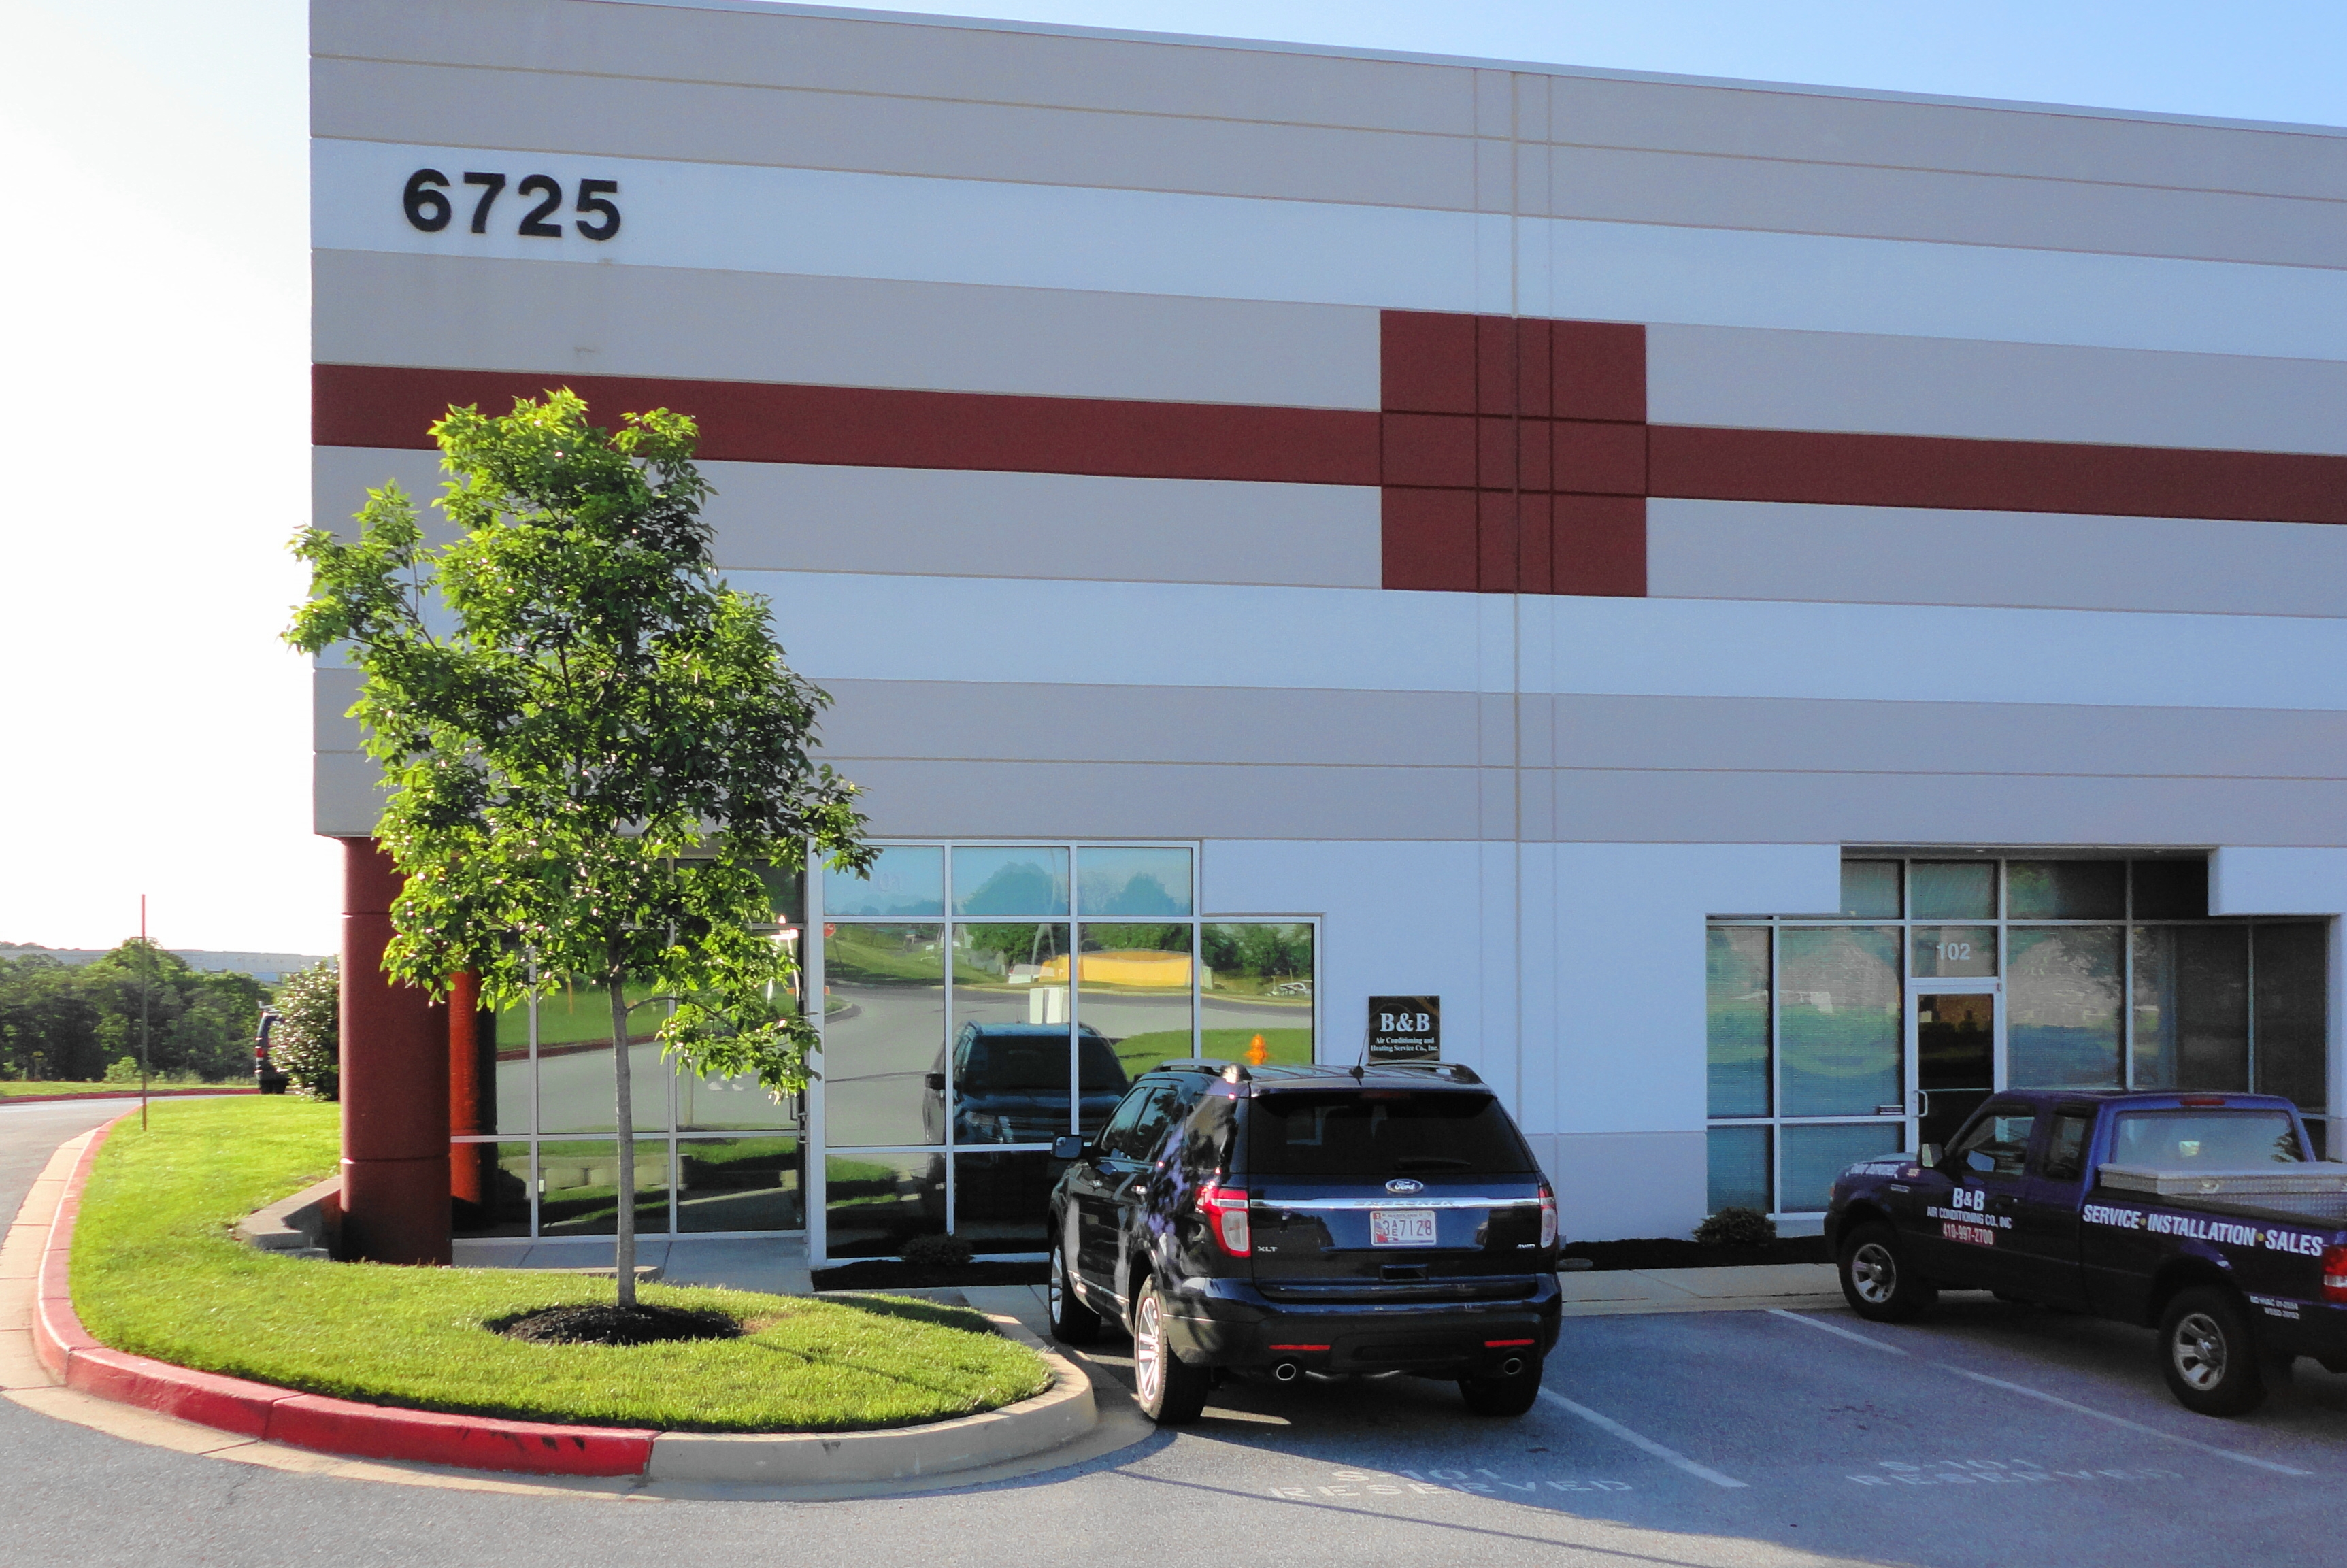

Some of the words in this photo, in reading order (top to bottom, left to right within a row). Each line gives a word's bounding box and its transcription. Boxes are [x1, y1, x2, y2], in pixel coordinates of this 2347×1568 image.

[403, 168, 620, 241] 6725
[1935, 942, 1971, 961] 102
[1380, 1012, 1431, 1032] B&B
[1394, 1180, 1416, 1190] Ford
[1952, 1187, 1985, 1211] B&B
[1927, 1206, 1937, 1218] AIR
[1939, 1207, 1984, 1224] CONDITIONING
[1942, 1222, 1994, 1245] 410-997-2700
[2082, 1204, 2142, 1229] SERVICE
[2146, 1213, 2257, 1247] INSTALLATION
[2264, 1229, 2324, 1257] SALES
[1846, 1469, 2184, 1486] RESERVED
[1269, 1480, 1633, 1499] RESERVED
